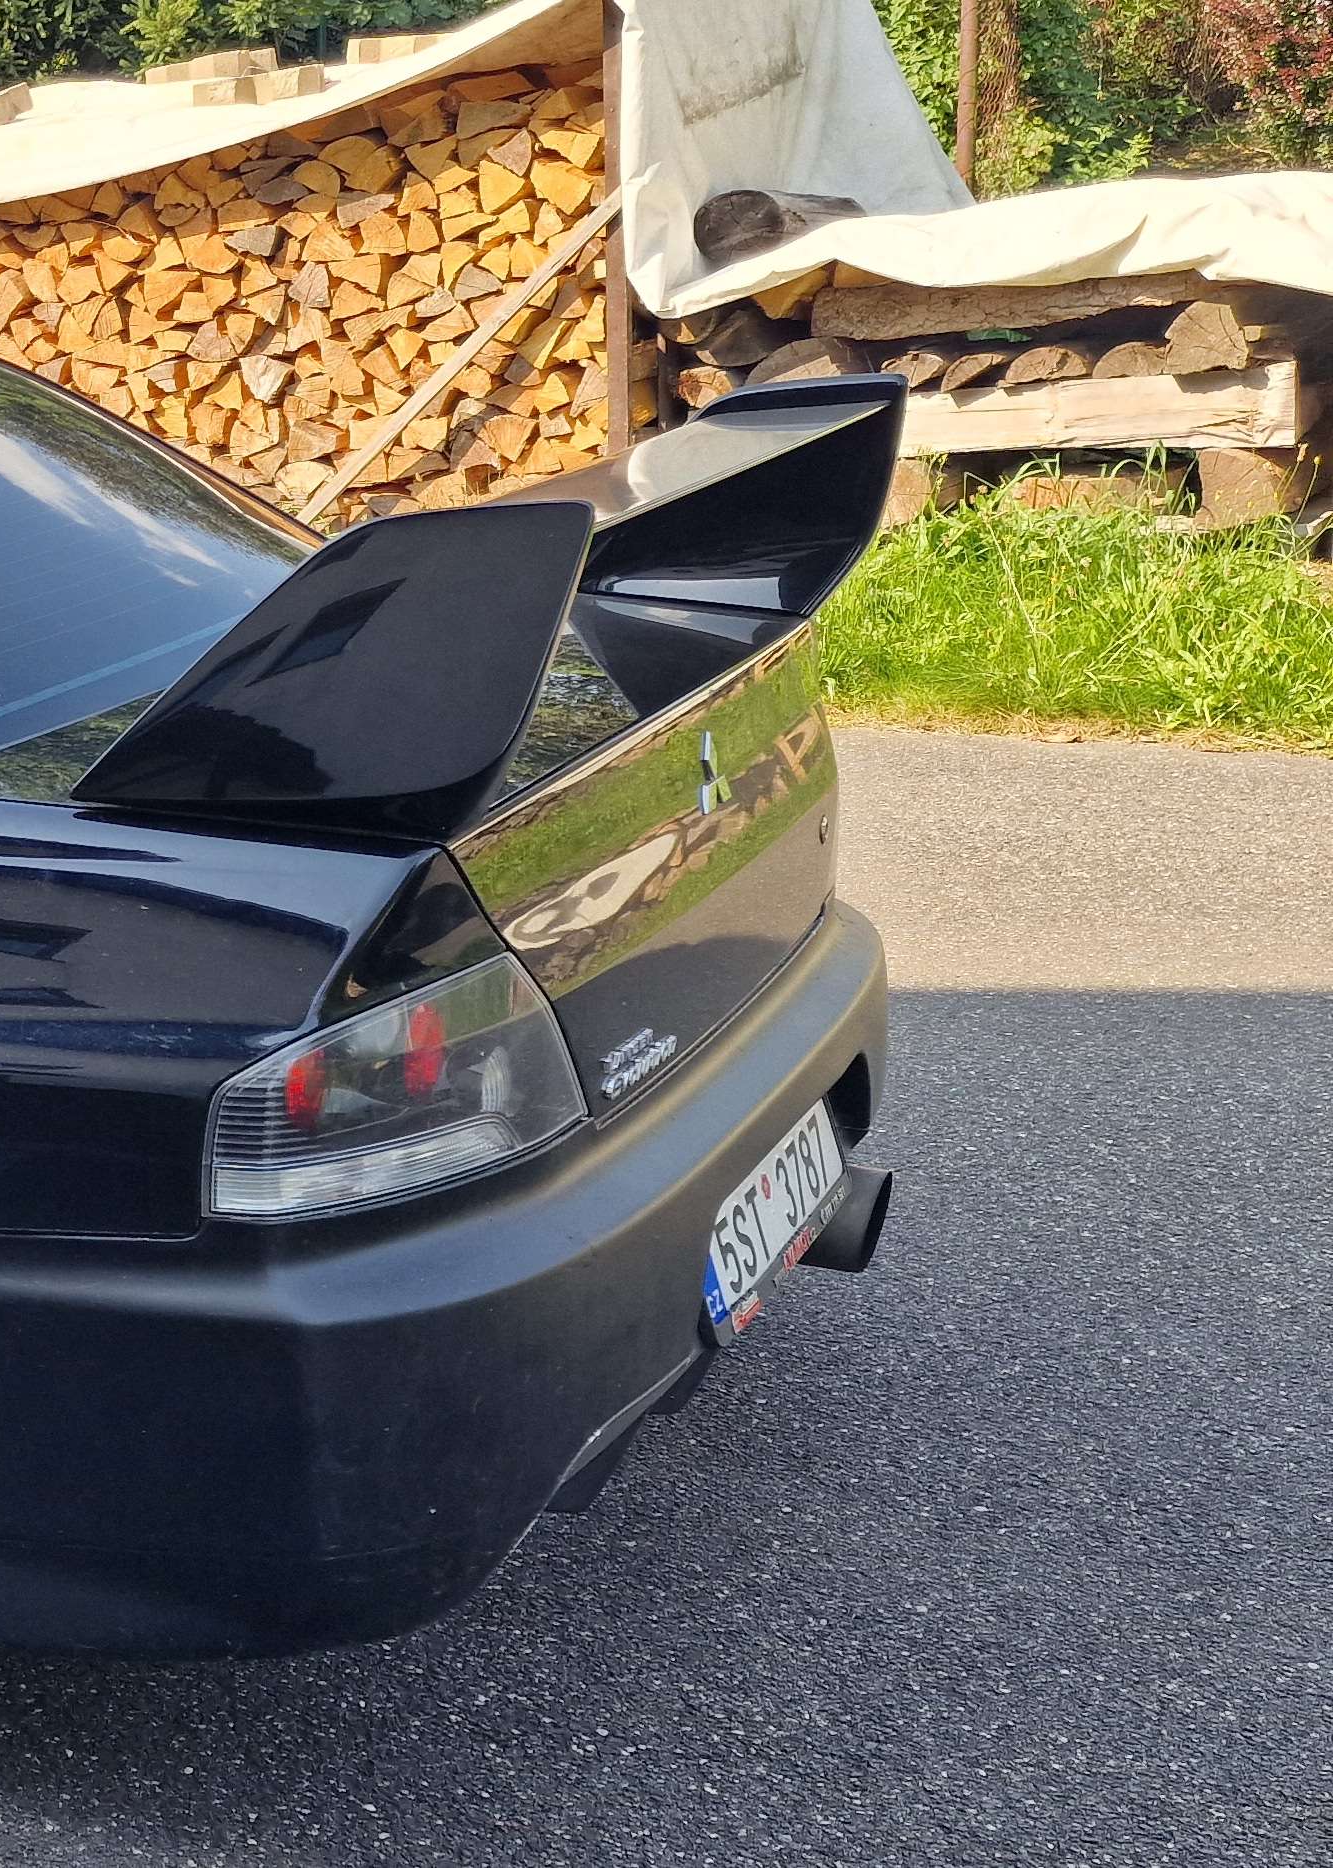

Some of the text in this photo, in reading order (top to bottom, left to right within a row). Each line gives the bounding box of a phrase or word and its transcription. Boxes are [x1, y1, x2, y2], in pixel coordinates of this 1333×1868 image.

[714, 1183, 771, 1294] 5ST
[775, 1113, 829, 1228] 3787
[705, 1288, 724, 1319] CZ
